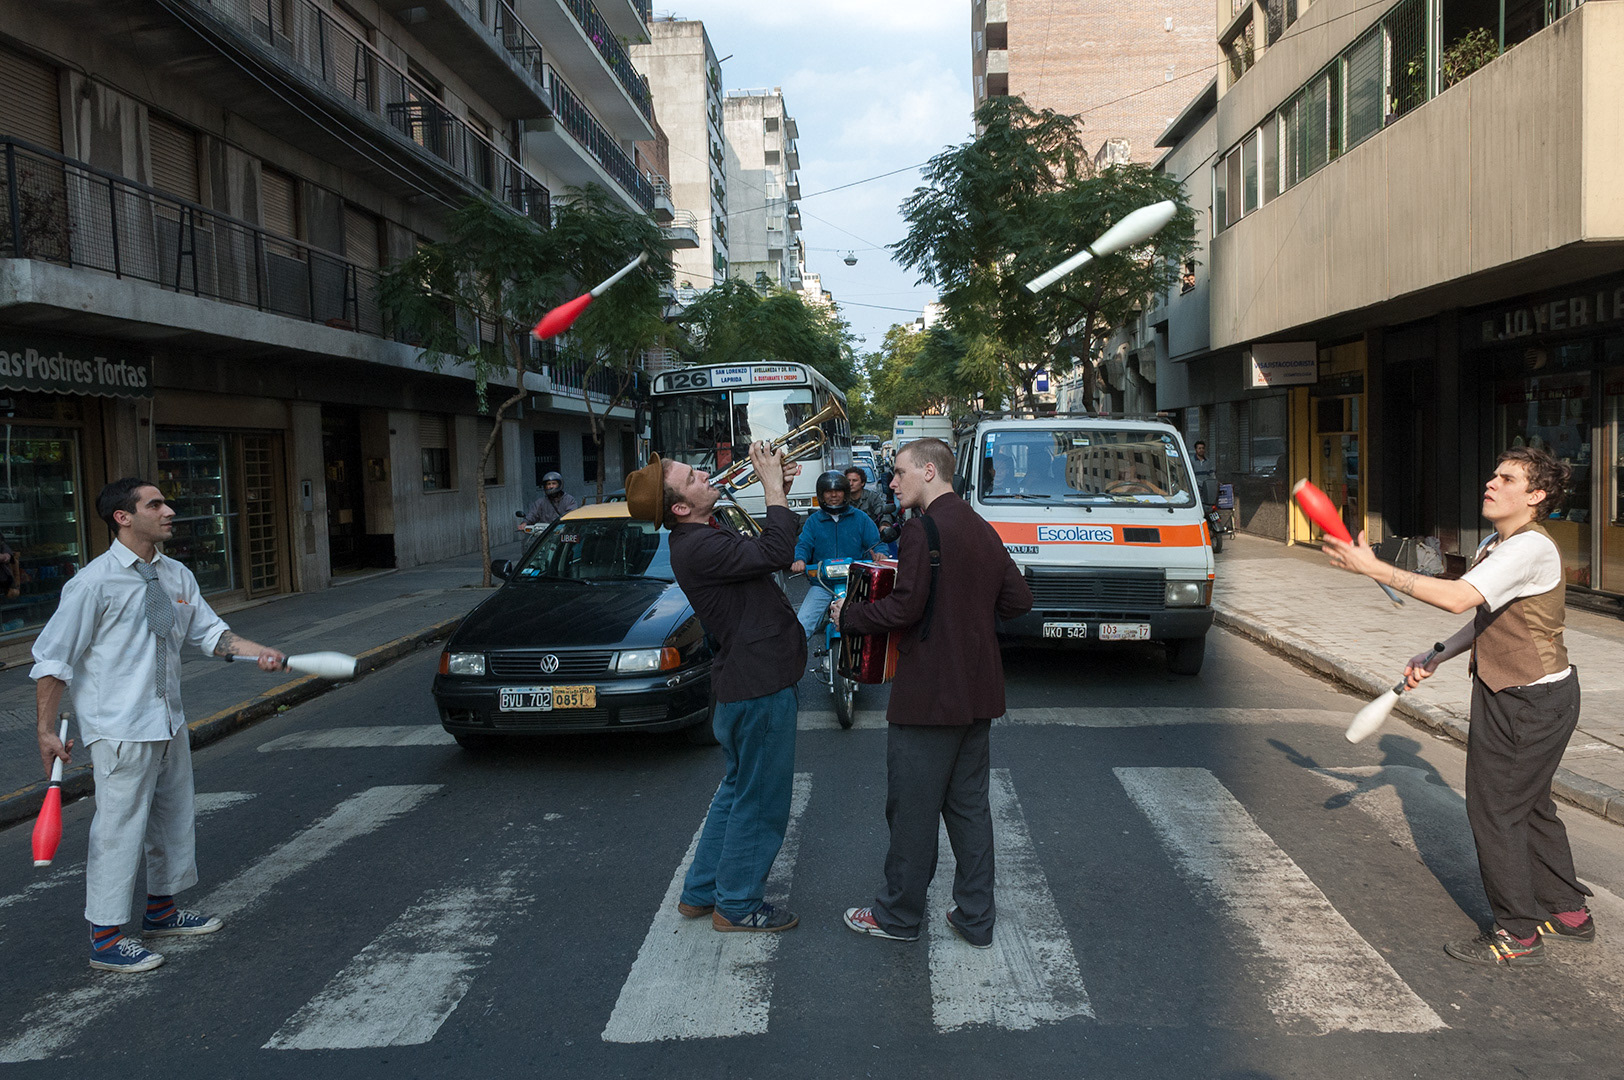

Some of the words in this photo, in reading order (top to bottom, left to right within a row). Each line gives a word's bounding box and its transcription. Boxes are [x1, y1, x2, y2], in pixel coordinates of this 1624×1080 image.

[25, 348, 93, 383] Postres
[94, 356, 147, 388] Tortas
[726, 367, 748, 375] LORENZO
[664, 372, 708, 389] 126
[561, 534, 578, 543] LIBRE
[1038, 526, 1113, 542] Escolares
[1007, 546, 1039, 554] NAULT
[1067, 627, 1085, 638] 542
[1102, 625, 1118, 635] 103
[1139, 628, 1149, 636] 17
[502, 694, 523, 707] BVU
[529, 693, 550, 707] 702
[556, 694, 583, 706] 0851
